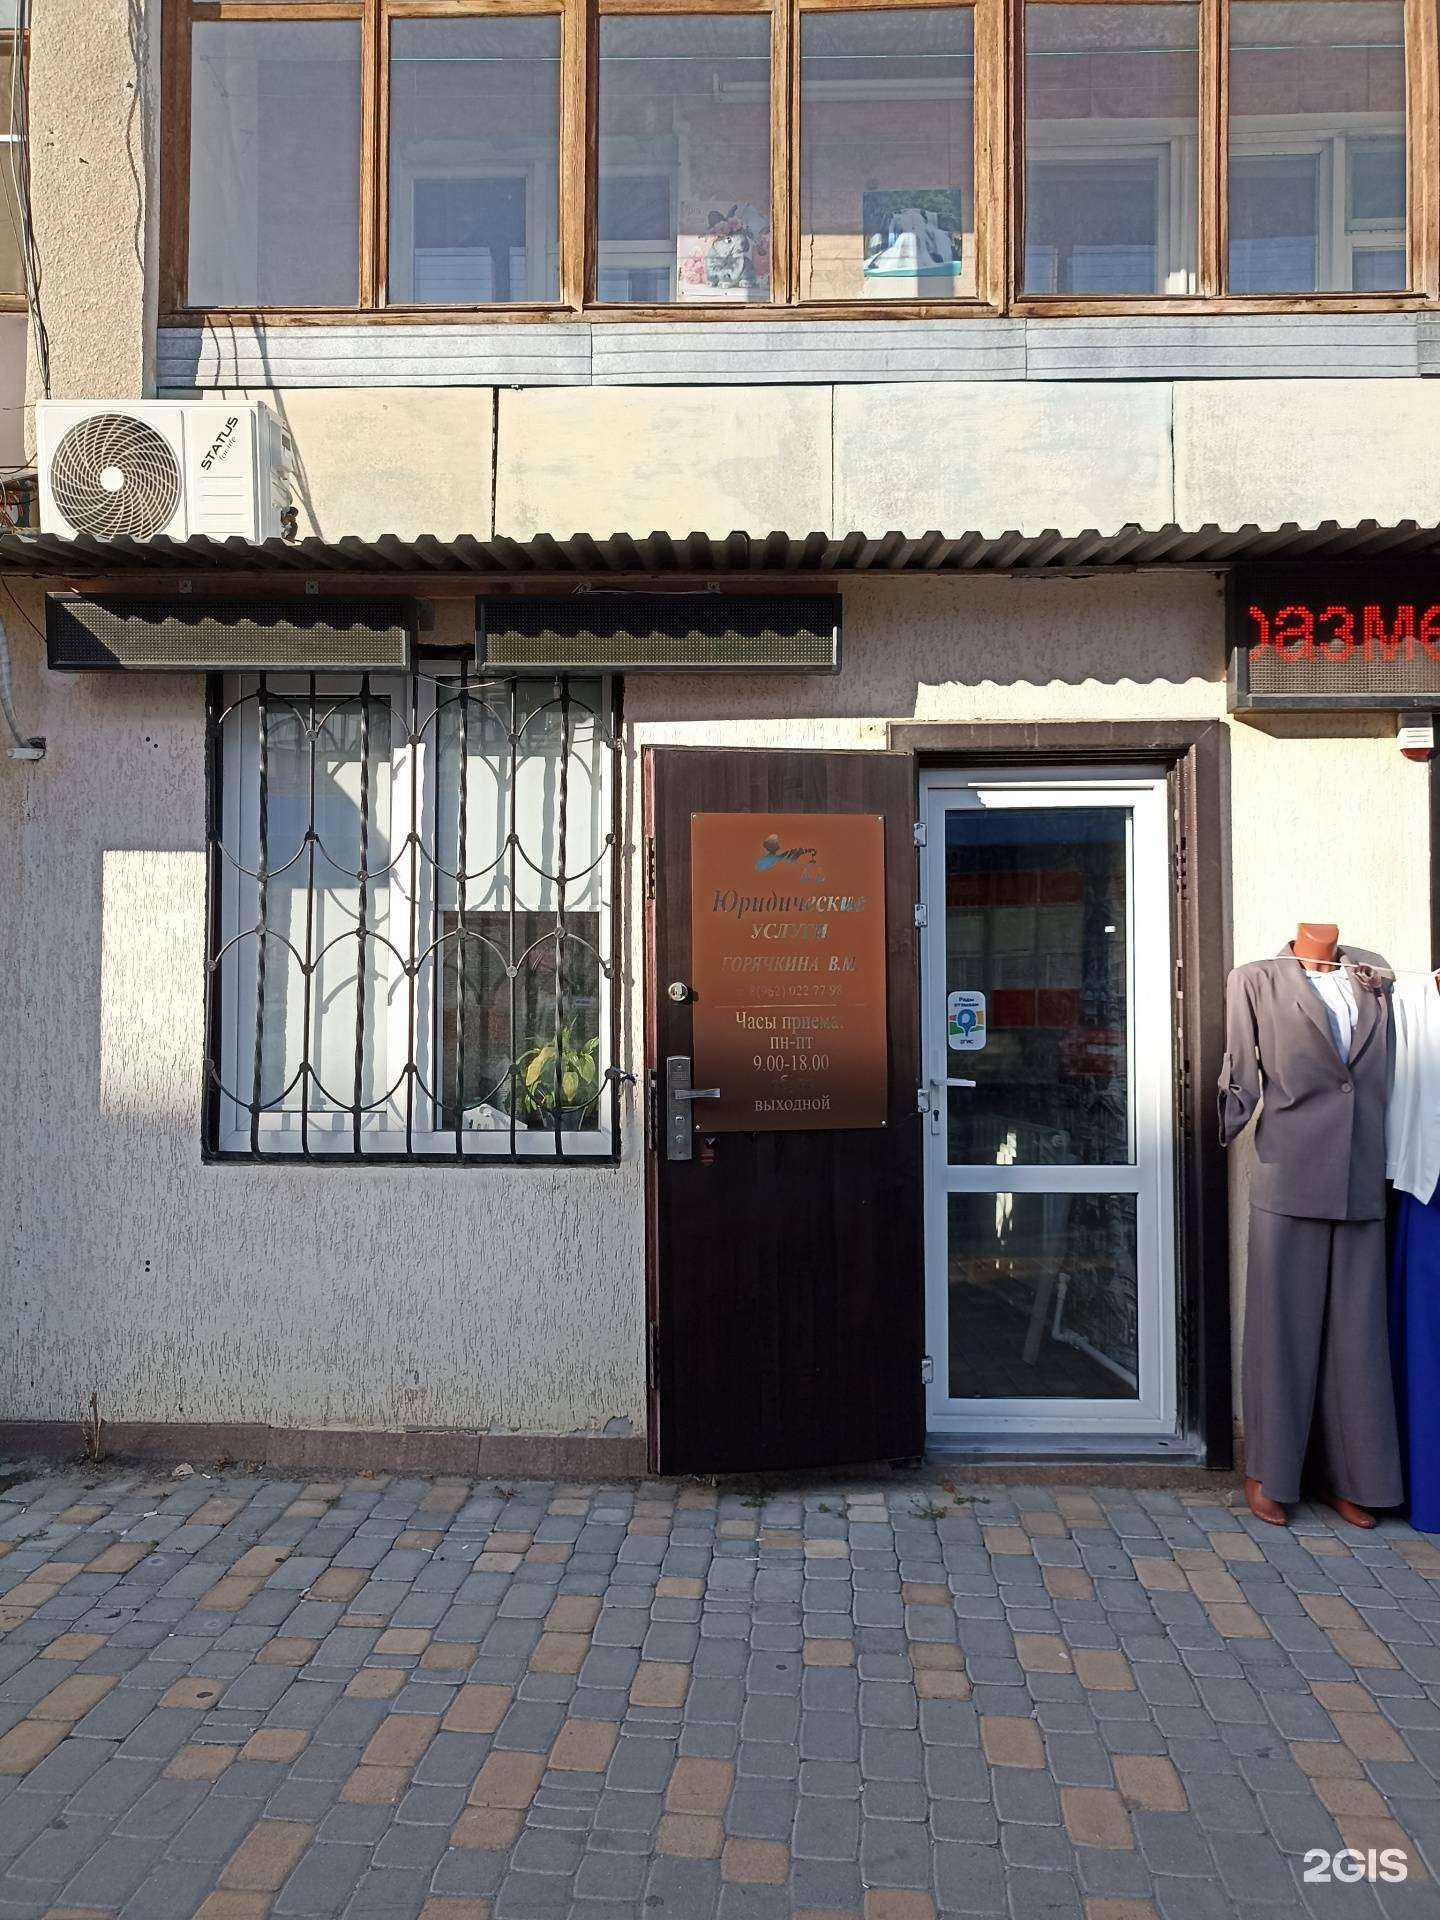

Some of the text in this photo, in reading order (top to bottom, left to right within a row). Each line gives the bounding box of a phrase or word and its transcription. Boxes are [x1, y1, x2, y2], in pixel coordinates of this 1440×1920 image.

[201, 416, 239, 471] STATUS
[712, 887, 866, 919] Юридические
[721, 955, 820, 973] ГОРЯЧКИНА
[736, 1011, 777, 1030] Часы
[753, 1054, 830, 1072] 9.00-18.00
[755, 1095, 832, 1112] выходной
